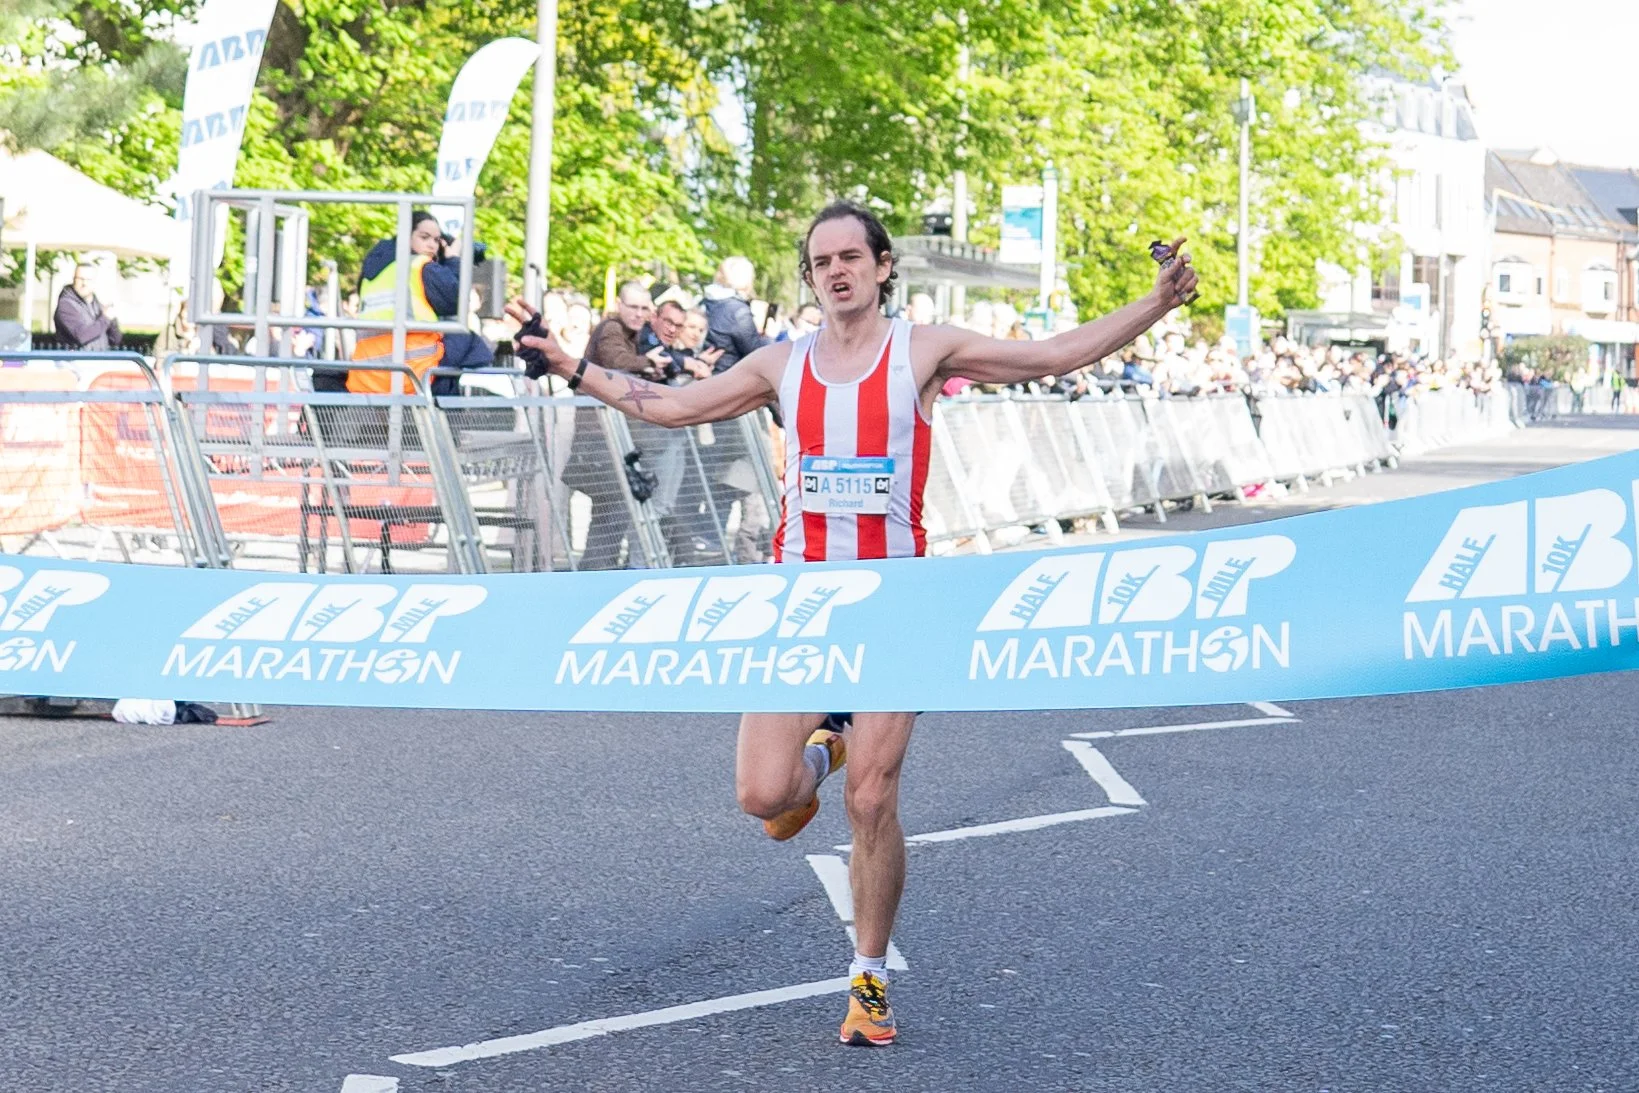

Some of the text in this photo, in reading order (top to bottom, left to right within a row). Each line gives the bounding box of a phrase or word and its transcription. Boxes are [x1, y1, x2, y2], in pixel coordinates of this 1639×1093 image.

[821, 477, 872, 494] A 5115
[828, 498, 864, 508] Richard
[1542, 535, 1580, 574] 10K
[976, 534, 1297, 632] ABP
[1107, 573, 1150, 607] 10K
[1201, 556, 1252, 602] MILE
[12, 585, 67, 620] MILE
[179, 582, 488, 643] ABP
[304, 602, 345, 631] 10K
[391, 597, 443, 633] MILE
[568, 569, 882, 644] ABP
[697, 597, 738, 628] 10K
[785, 585, 839, 626] MILE
[160, 643, 462, 684] MARATHON
[554, 643, 866, 685] MARATHON
[968, 621, 1290, 680] MARATHON
